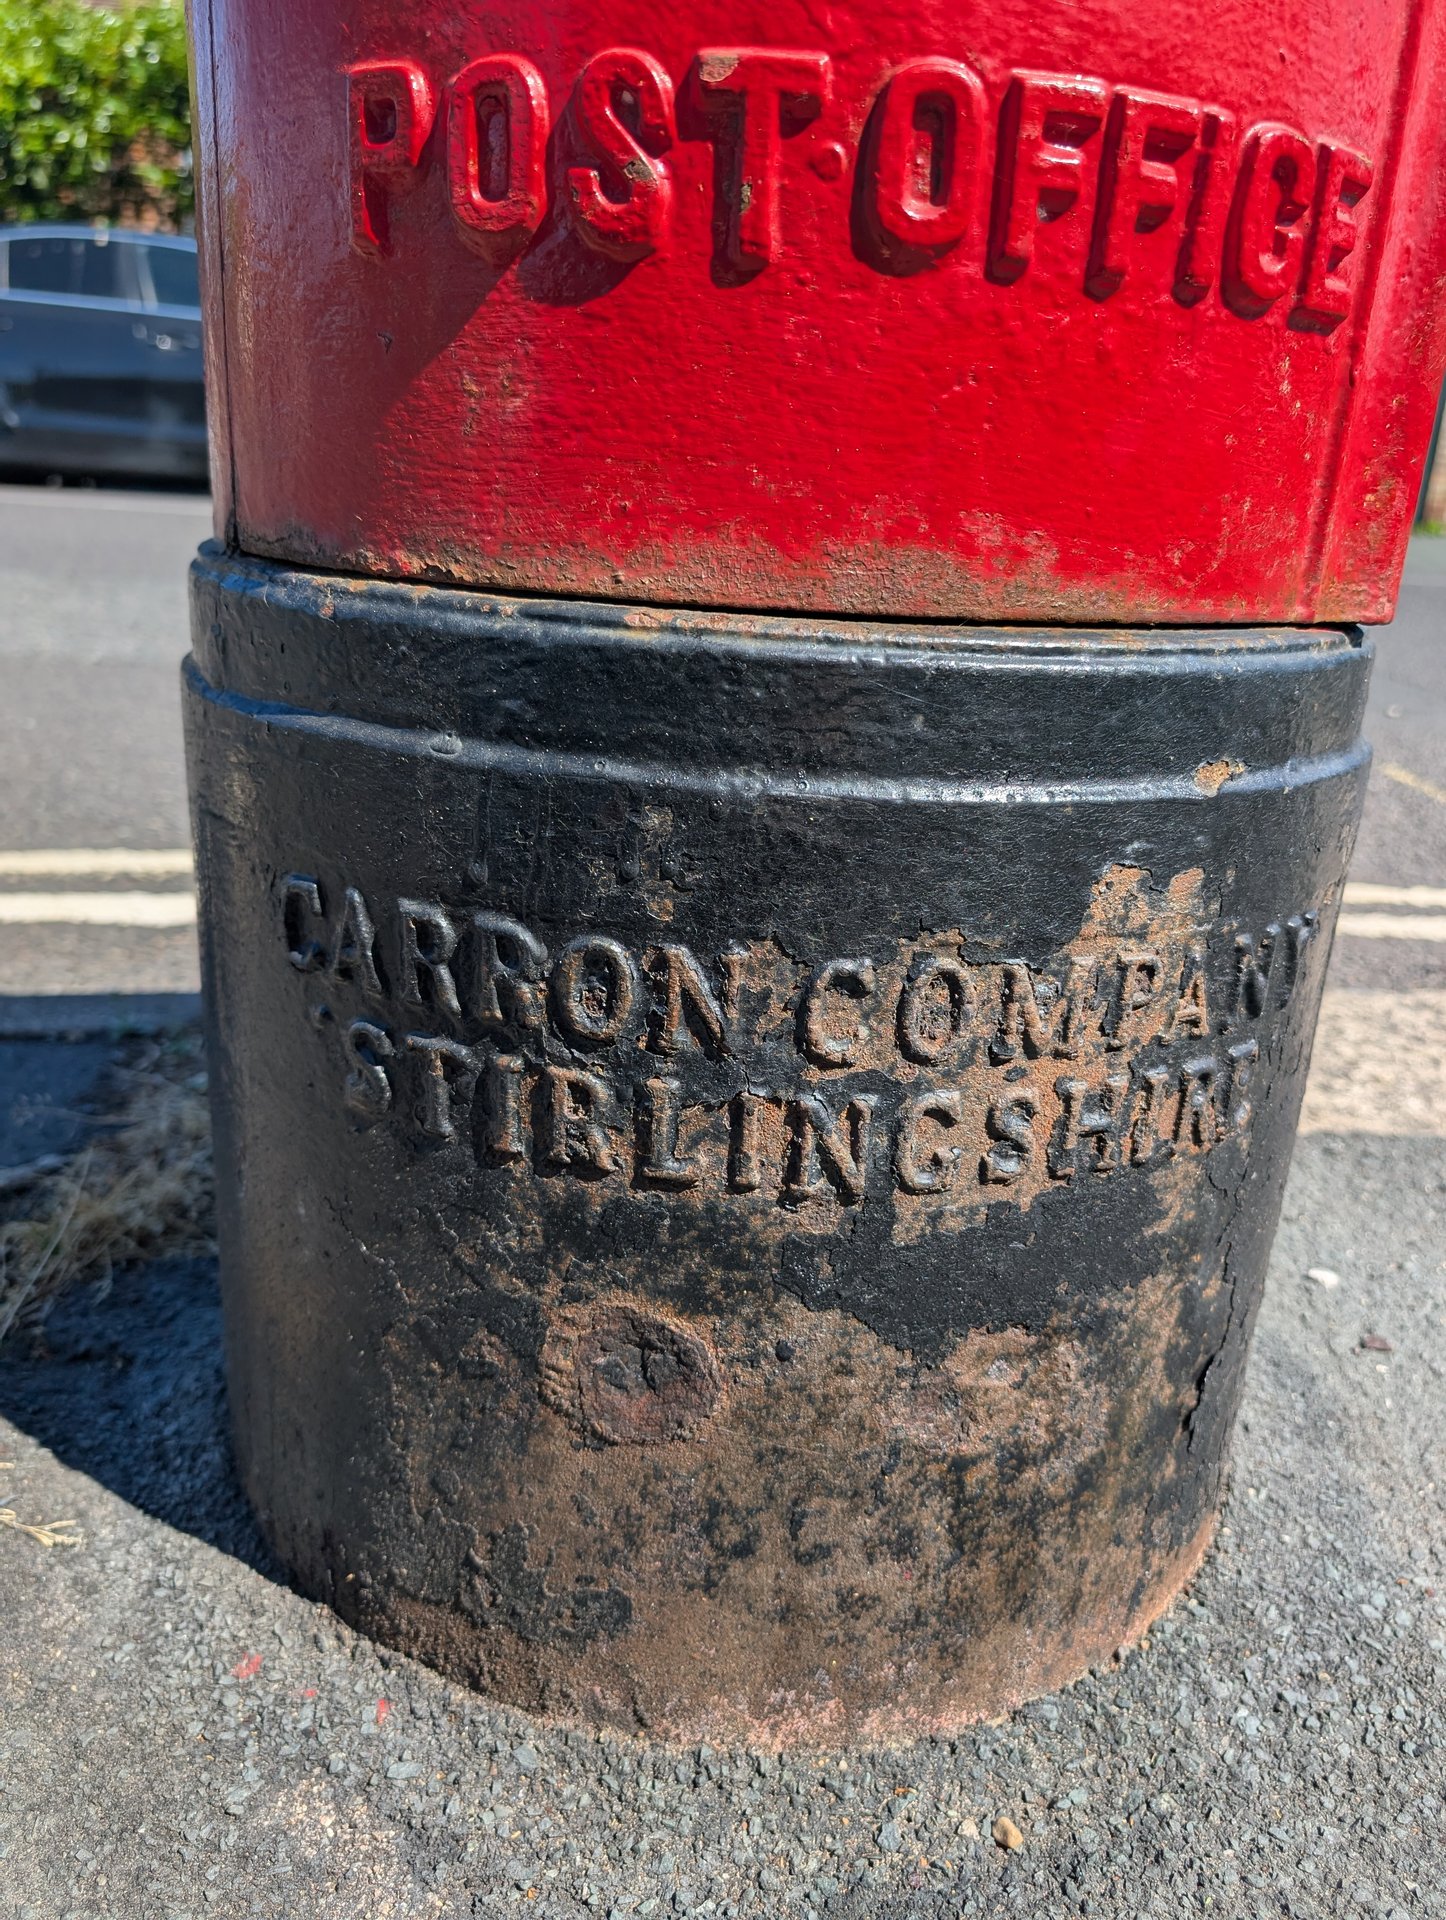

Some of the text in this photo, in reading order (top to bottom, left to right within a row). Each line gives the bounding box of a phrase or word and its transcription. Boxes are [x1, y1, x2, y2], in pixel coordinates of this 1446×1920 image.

[345, 47, 1376, 334] POST OFFICE
[279, 874, 1318, 1068] CARRON COMPANY
